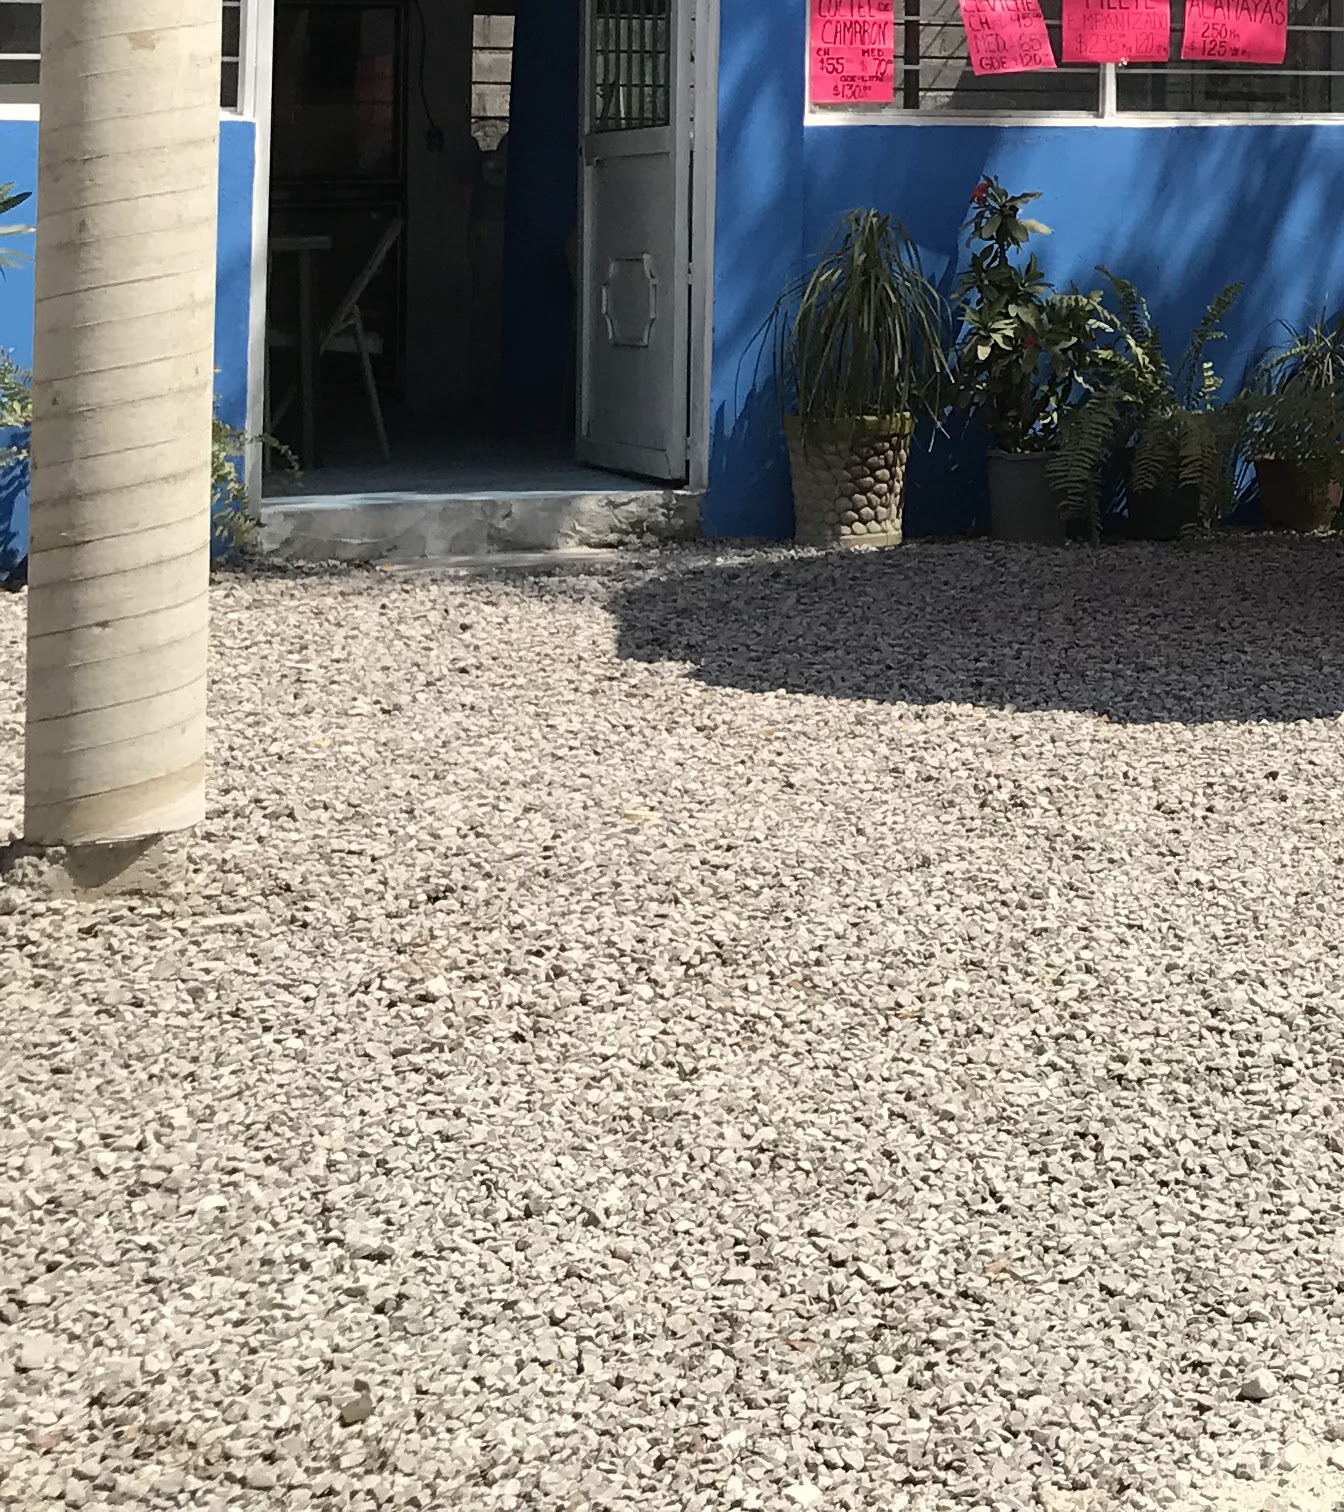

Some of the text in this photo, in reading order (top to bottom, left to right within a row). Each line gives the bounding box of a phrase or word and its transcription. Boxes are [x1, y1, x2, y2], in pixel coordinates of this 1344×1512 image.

[968, 14, 990, 32] CH
[821, 20, 888, 46] CAMARON
[816, 48, 884, 58] CH MED
[979, 56, 1009, 70] GDE
